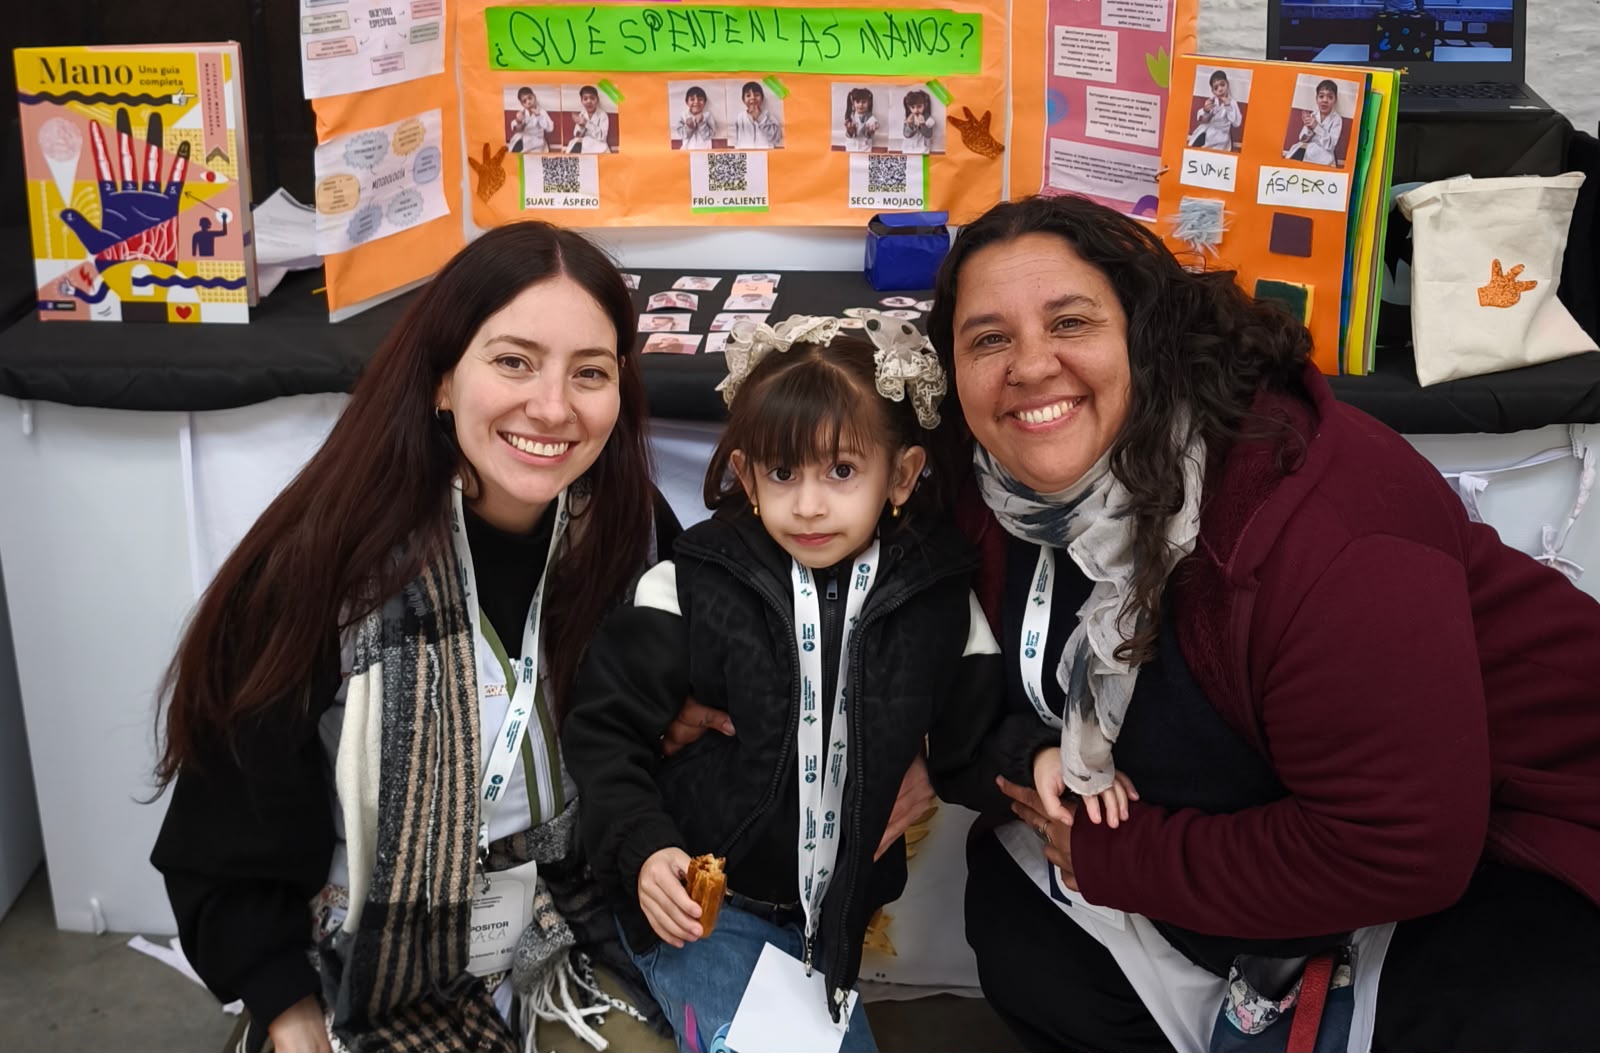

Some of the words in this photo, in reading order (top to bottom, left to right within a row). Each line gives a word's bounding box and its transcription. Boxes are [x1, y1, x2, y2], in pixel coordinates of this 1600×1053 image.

[859, 11, 974, 60] MANOS?
[39, 56, 134, 85] Mano
[138, 65, 158, 74] Una
[138, 78, 184, 87] completa
[1187, 160, 1231, 181] SUAVE
[1265, 170, 1339, 196] ÁSPERO
[525, 197, 555, 206] SUAVE
[562, 196, 599, 207] ÁSPERO
[693, 196, 715, 206] FRÍO
[722, 196, 767, 206] CALIENTE
[851, 196, 875, 206] SECO
[882, 197, 924, 208] MOJADO
